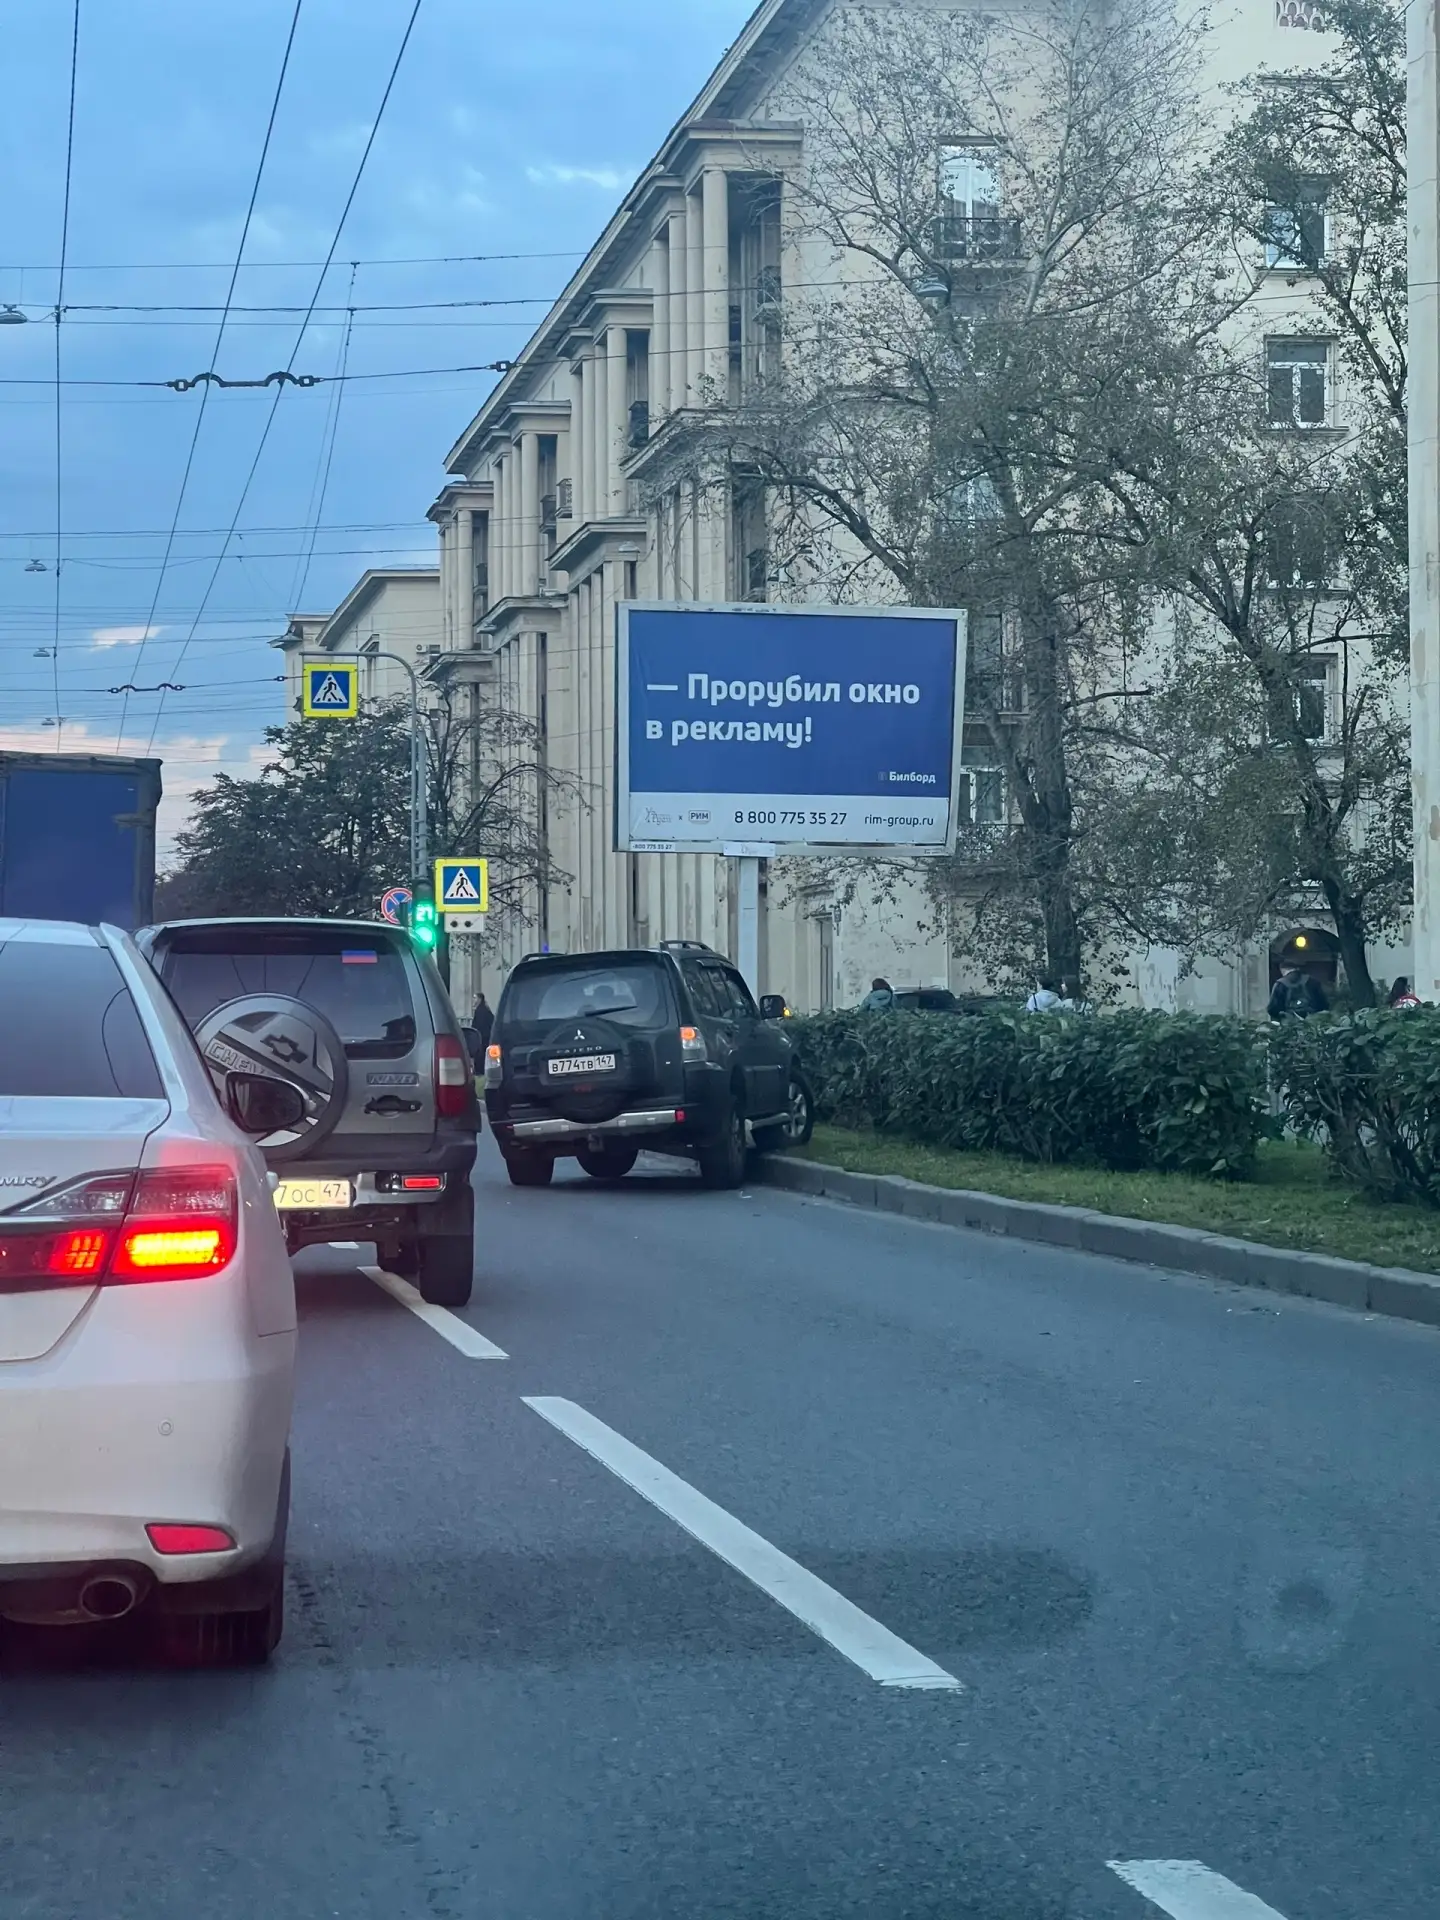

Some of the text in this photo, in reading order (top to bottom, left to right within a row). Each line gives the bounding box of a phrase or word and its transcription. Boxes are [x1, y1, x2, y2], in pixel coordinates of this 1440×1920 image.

[688, 673, 840, 707] Прорубил
[849, 683, 920, 704] окно
[646, 717, 812, 748] в рекламу!
[889, 771, 936, 784] Билборд
[690, 811, 709, 820] РИМ
[734, 811, 848, 825] 8 800 775 35 27
[864, 814, 934, 828] rim-group.ru
[596, 1056, 612, 1066] 147
[323, 1183, 341, 1198] 47
